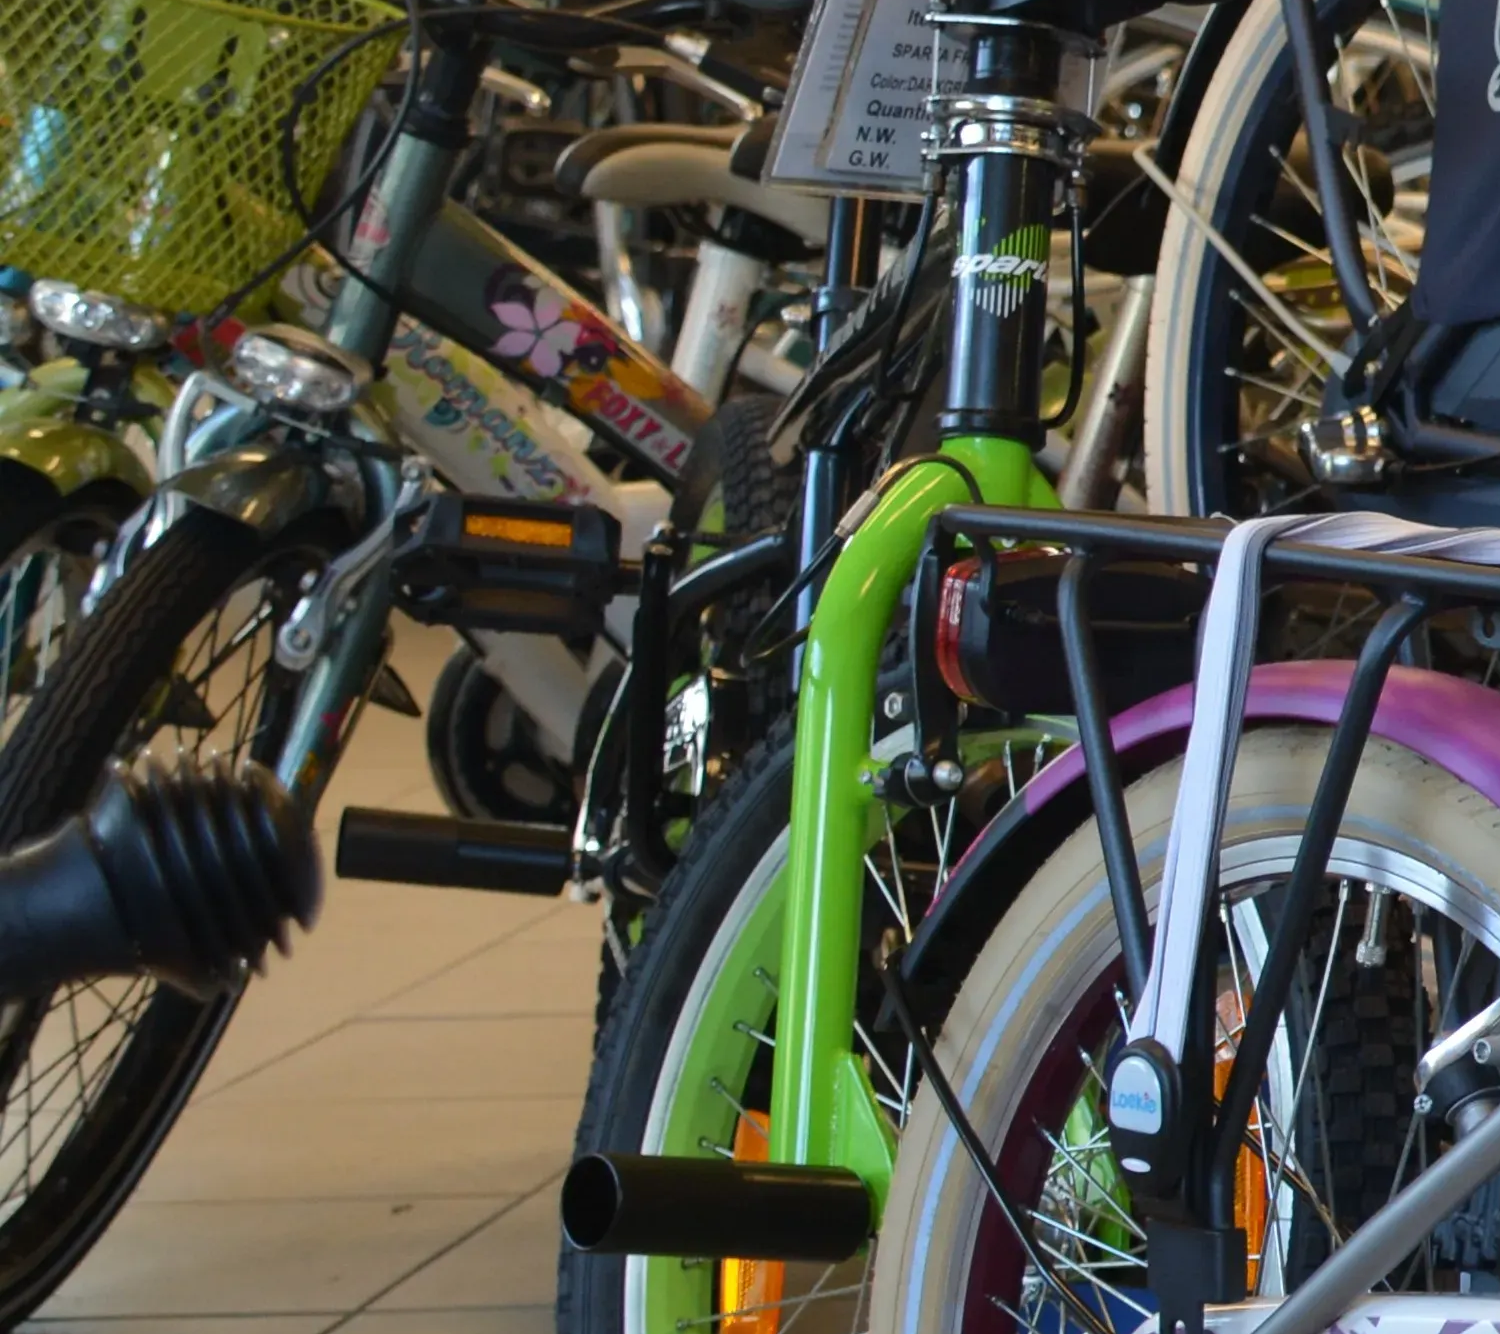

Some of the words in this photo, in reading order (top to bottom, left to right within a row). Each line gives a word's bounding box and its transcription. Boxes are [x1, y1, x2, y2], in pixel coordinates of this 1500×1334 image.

[855, 125, 897, 145] N.W.
[848, 149, 890, 169] G.W.
[585, 378, 664, 441] FOXY
